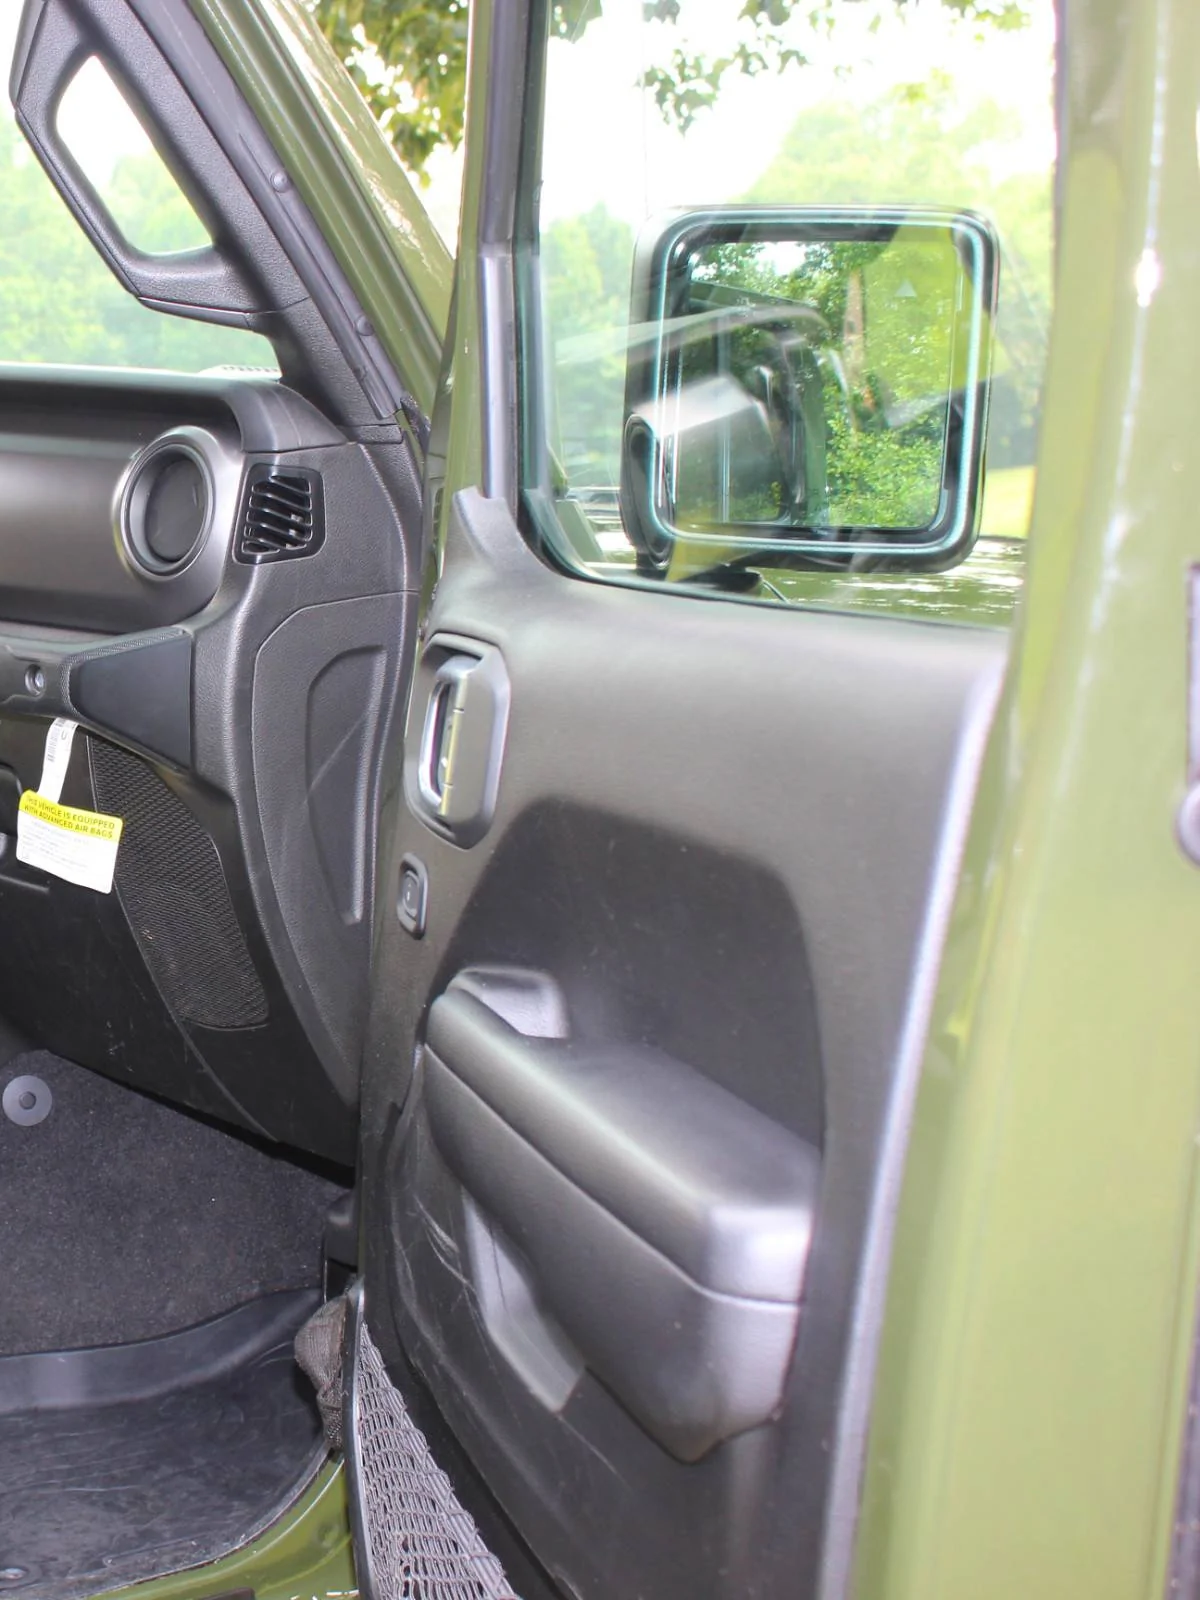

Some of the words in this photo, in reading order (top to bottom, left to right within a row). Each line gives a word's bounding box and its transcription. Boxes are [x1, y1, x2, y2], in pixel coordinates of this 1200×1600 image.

[24, 805, 38, 814] WITH
[39, 811, 73, 828] ADVANCED
[74, 823, 89, 833] AIR
[90, 827, 113, 838] BAGS
[38, 800, 62, 817] VEHICLE
[63, 811, 71, 819] IS
[72, 814, 115, 830] EQUIPPED
